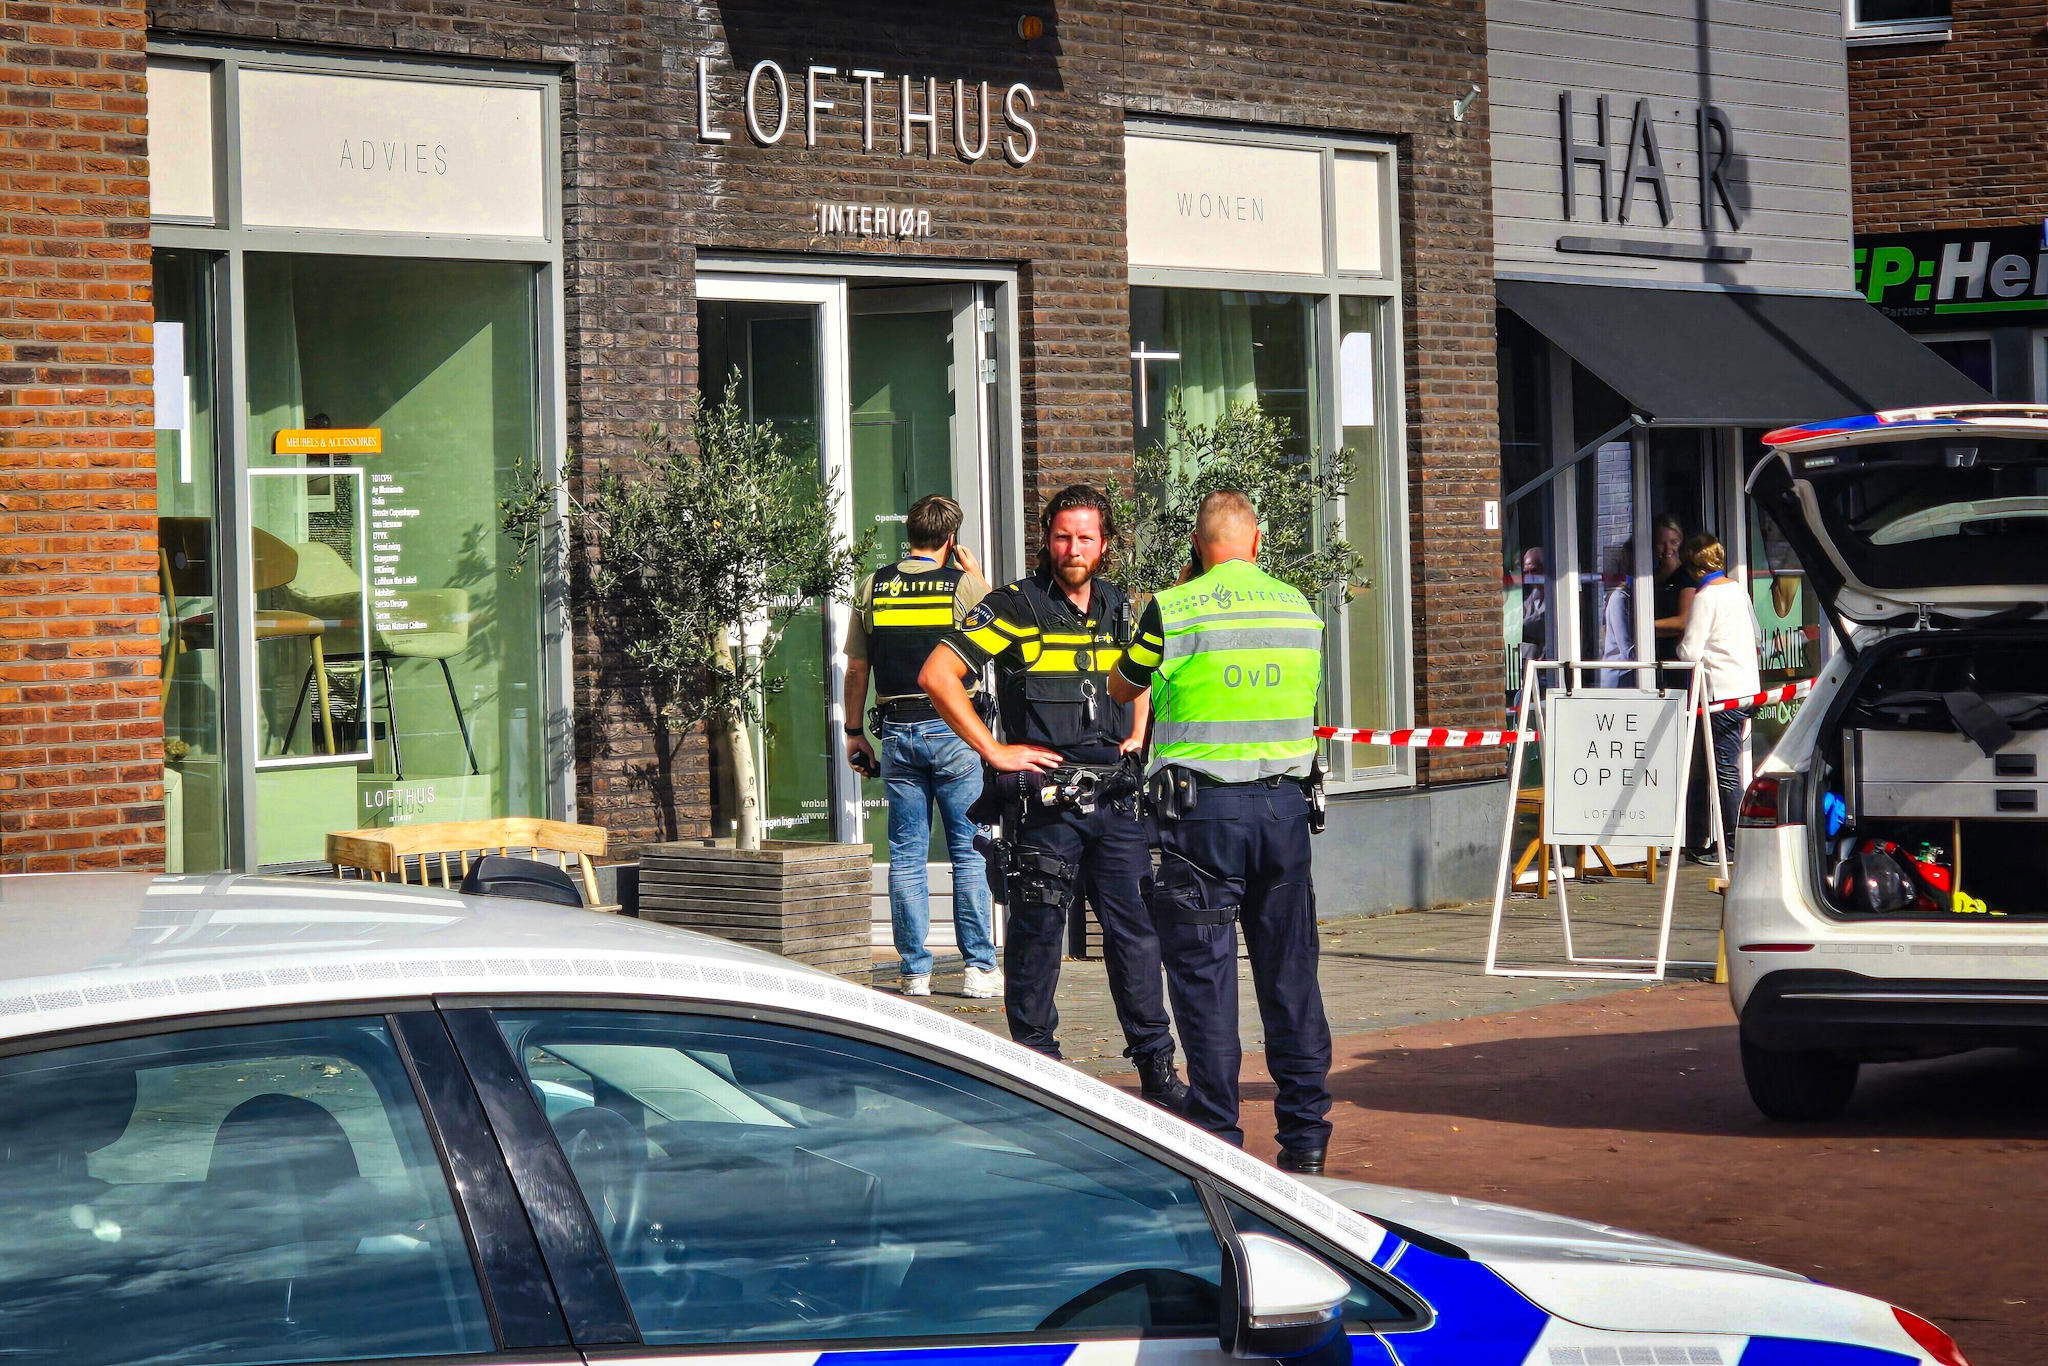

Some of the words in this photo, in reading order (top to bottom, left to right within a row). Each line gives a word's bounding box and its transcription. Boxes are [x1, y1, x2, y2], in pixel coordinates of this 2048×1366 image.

[698, 56, 1038, 164] LOFTHUS
[339, 138, 448, 176] ADVIES
[1176, 191, 1264, 222] WONEN
[286, 437, 319, 447] MEUBELS
[320, 438, 326, 447] &
[328, 437, 377, 447] ACCESSOIRES
[1224, 663, 1281, 688] OvD
[1595, 713, 1638, 732] WE
[1586, 740, 1647, 760] ARE
[1573, 767, 1658, 787] OPEN
[365, 786, 435, 808] LOFTHUS
[1583, 809, 1646, 820] LOFTHUS
